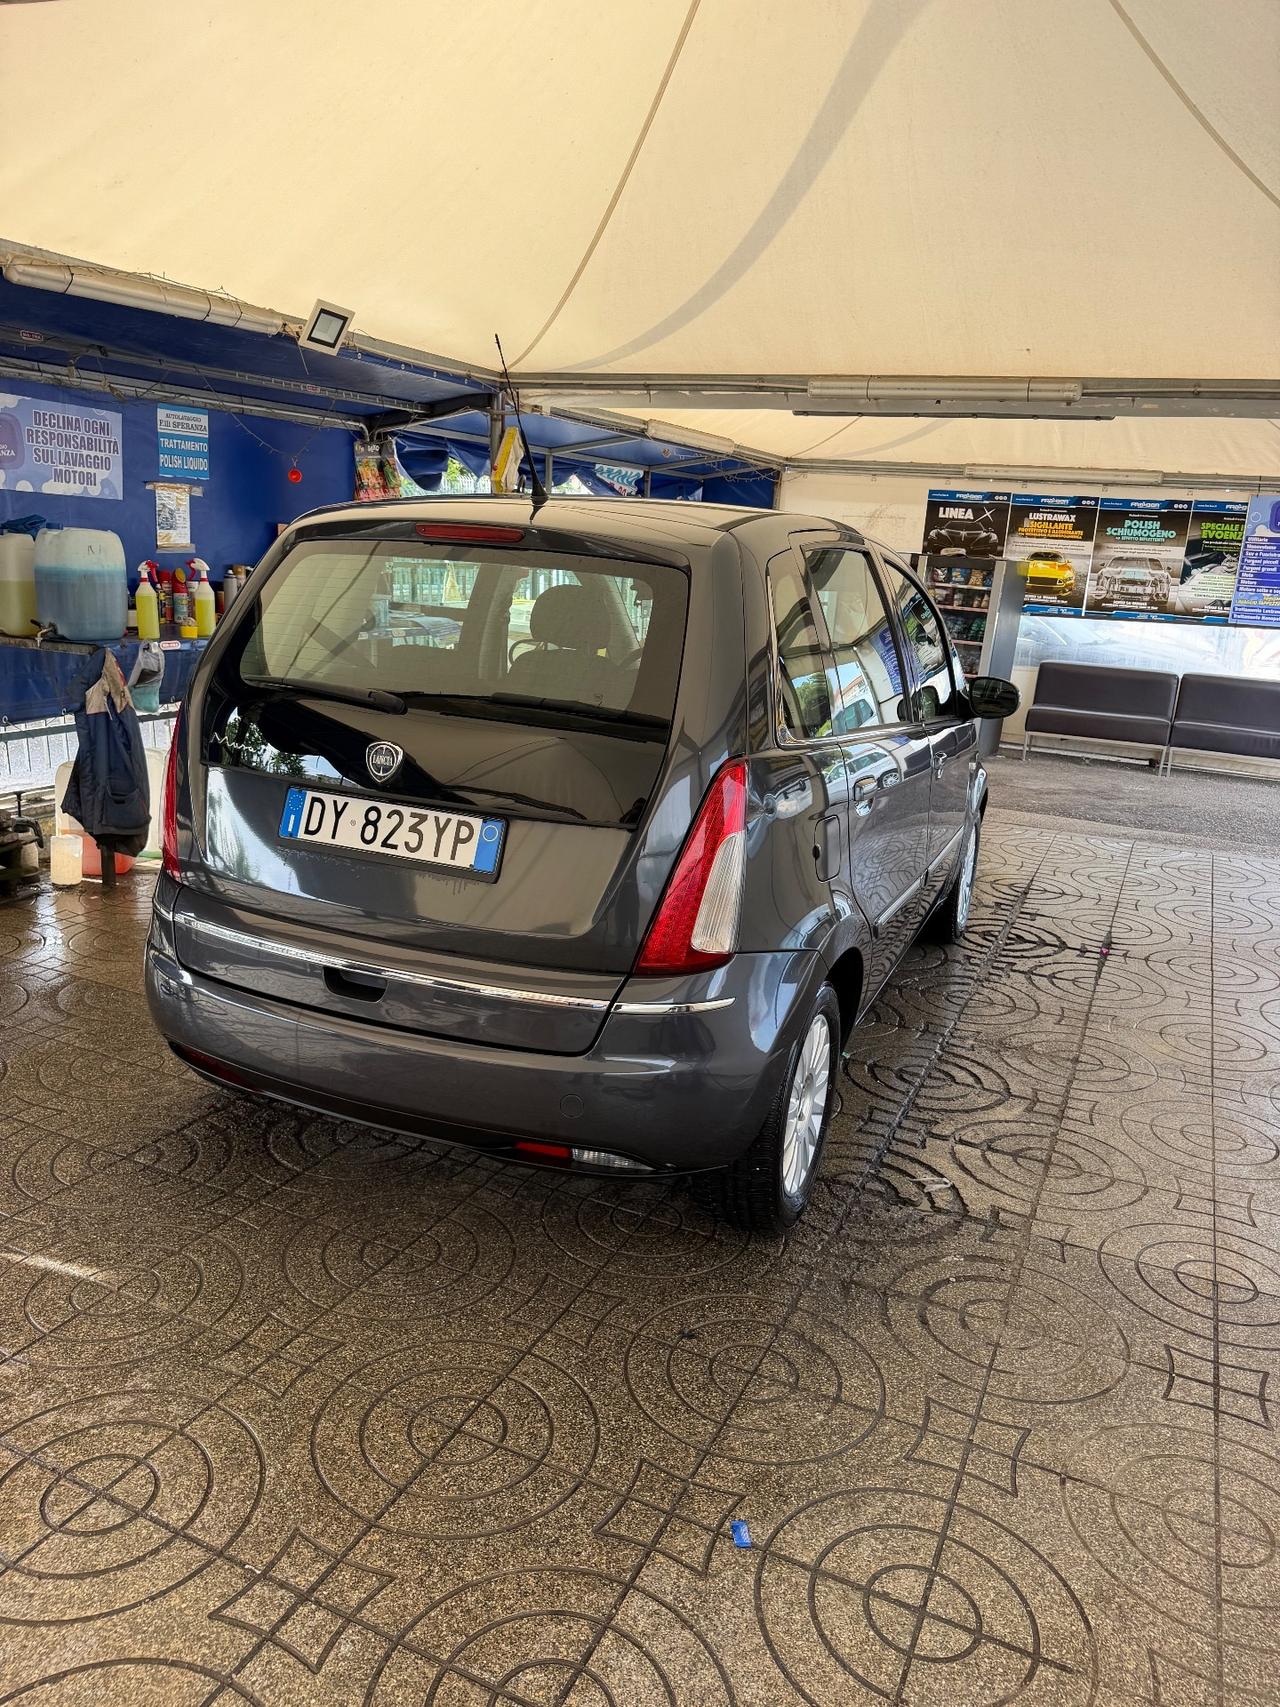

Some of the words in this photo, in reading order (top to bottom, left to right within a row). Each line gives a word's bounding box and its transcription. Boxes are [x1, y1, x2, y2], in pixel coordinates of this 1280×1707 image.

[33, 410, 81, 432] DECLINA
[83, 418, 110, 437] OGNI
[172, 421, 208, 432] SPERANZA
[26, 427, 119, 455] RESPONSABILITÀ
[160, 438, 208, 452] TRATTAMENTO
[33, 447, 55, 465] SUL
[58, 450, 111, 471] LAVAGGIO
[160, 454, 183, 469] POLISH
[183, 456, 208, 471] LIQUIDO
[53, 468, 97, 487] MOTORI
[938, 507, 974, 520] LINEA
[1028, 512, 1076, 523] LUSTRAWAX
[1029, 520, 1074, 531] SIGILLANTE
[1124, 519, 1160, 529] POLISH
[1200, 522, 1240, 532] SPECIALE
[1106, 526, 1177, 539] SCHIUMOGENO
[372, 754, 394, 766] LANCIA
[303, 796, 350, 840] DY
[360, 805, 475, 861] 823YP
